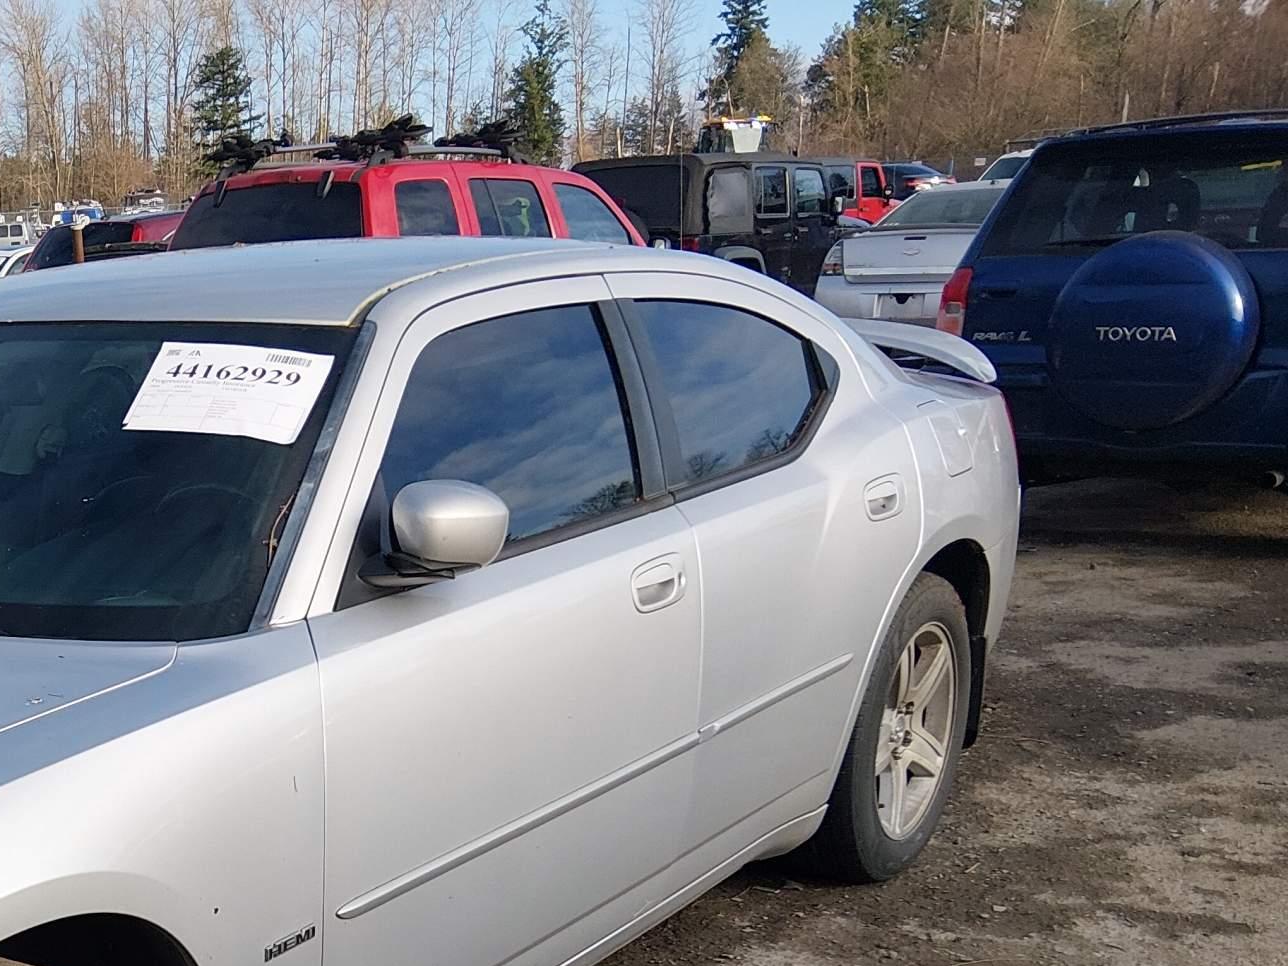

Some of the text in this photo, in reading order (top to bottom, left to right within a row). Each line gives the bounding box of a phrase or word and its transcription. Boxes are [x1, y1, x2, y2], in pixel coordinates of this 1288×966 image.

[1017, 330, 1032, 342] L
[1095, 326, 1177, 342] TOYOTA
[166, 362, 302, 387] 44162929
[264, 925, 316, 963] HEMI
